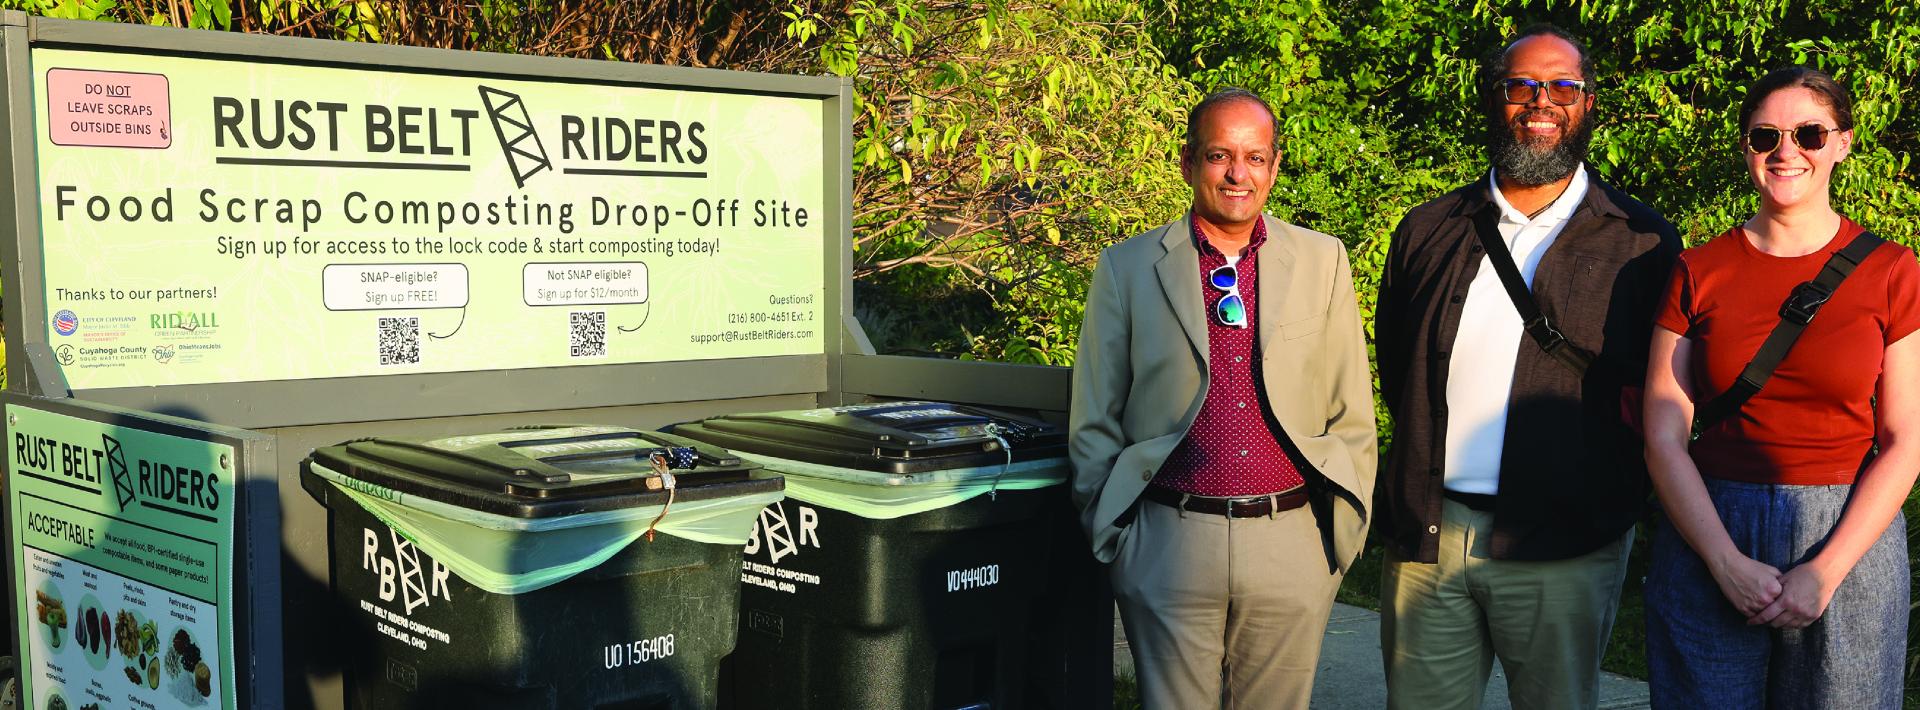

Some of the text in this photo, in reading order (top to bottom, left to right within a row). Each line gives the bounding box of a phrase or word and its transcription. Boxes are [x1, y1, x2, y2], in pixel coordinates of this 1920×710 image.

[85, 83, 131, 97] DO NOT
[67, 102, 153, 116] LEAVE SCRAPS
[70, 121, 151, 135] OUTSIDE BINS
[213, 96, 708, 165] RUST BELT RIDERS
[56, 185, 808, 234] Food Scrap Composting Drop-Off Site
[217, 236, 720, 258] Sign up for access to the lock code & start composting today!
[360, 271, 438, 285] SNAP-eligible?
[547, 269, 632, 282] Not SNAP eligible?
[56, 286, 217, 302] Thanks to our partners!
[365, 290, 438, 305] Sign up FREE!
[537, 287, 639, 301] Sign up for $12/month
[769, 294, 814, 304] Questions?
[728, 311, 814, 323] (216) 800-4651 Ext. 2
[690, 329, 814, 344] support@RustBeltRiders.com
[79, 346, 147, 355] Cuyahoga County
[15, 432, 219, 511] RUST BELT RIDERS
[28, 511, 96, 549] ACCEPTABLE
[799, 506, 820, 548] R
[168, 566, 183, 577] paper
[363, 528, 451, 602] R B R
[752, 563, 775, 576] RIDERS
[776, 567, 820, 585] COMPOSTING
[741, 573, 796, 594] CLEVELAND, OHIO
[360, 600, 450, 644] RUST BELT RIDERS COMPOSTING
[377, 622, 427, 651] CLEVELAND, OHIO
[626, 634, 675, 666] 156408
